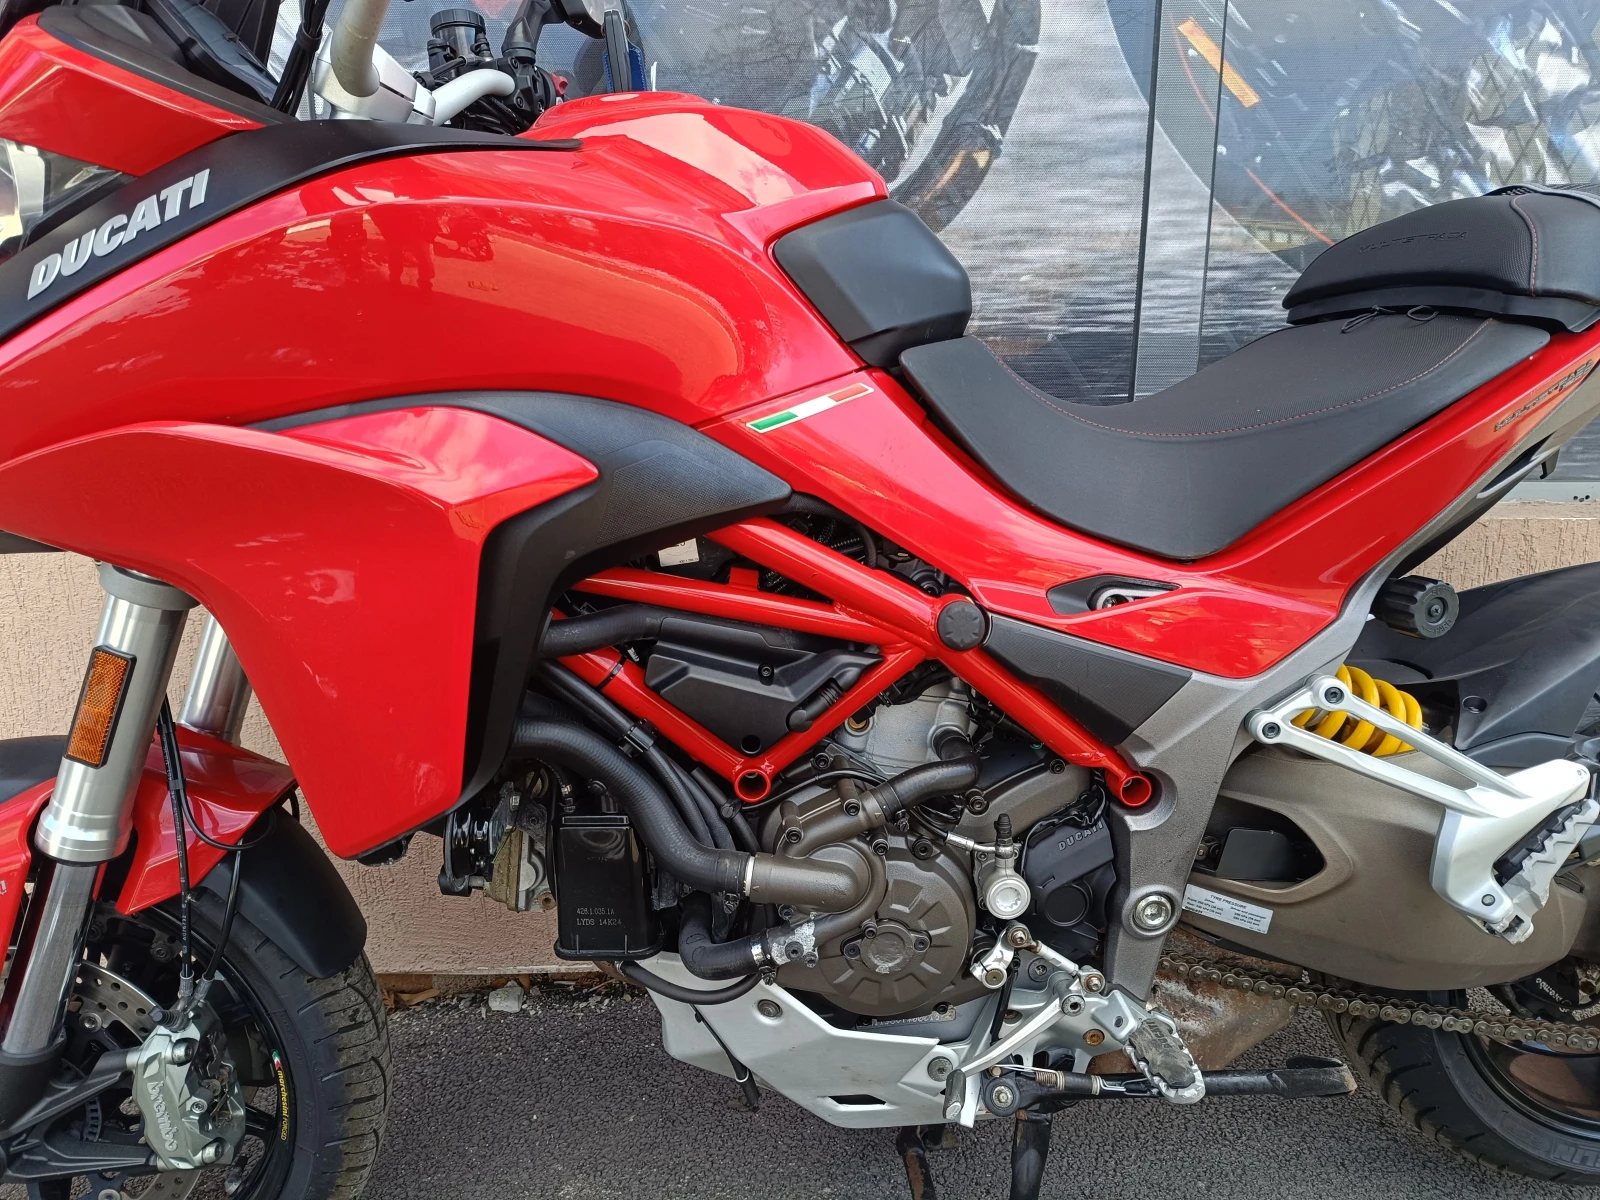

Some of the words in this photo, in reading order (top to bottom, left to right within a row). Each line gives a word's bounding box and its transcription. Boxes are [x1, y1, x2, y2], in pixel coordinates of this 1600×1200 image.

[28, 168, 210, 300] DUCATI
[1210, 894, 1222, 902] TYRE
[1222, 898, 1247, 909] PRESSURE
[146, 1081, 178, 1152] brembo
[278, 1070, 289, 1117] marchesini
